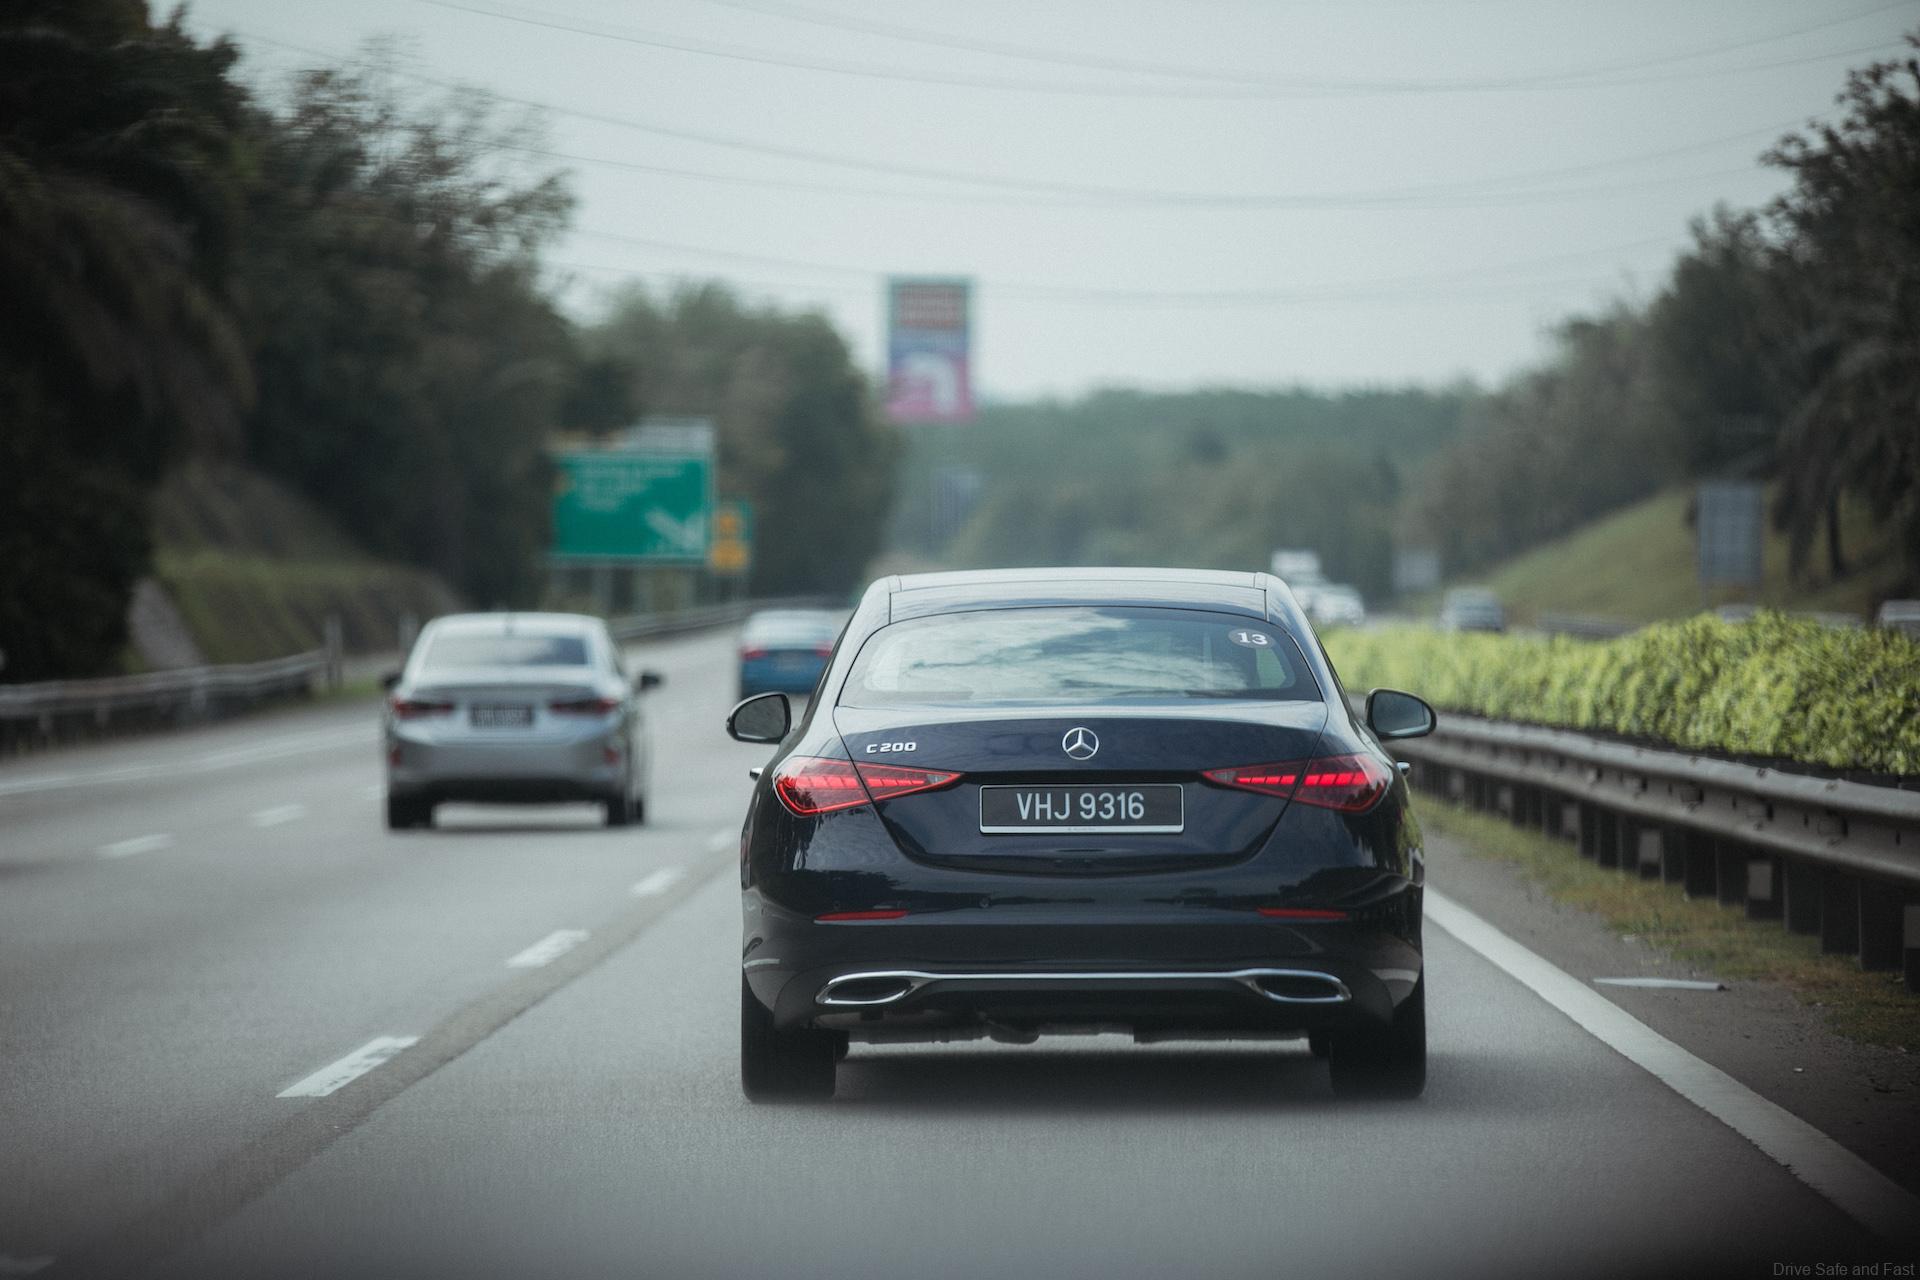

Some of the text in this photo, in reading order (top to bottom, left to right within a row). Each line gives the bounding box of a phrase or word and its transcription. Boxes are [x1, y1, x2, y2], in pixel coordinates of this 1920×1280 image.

[1237, 631, 1268, 645] 13
[866, 741, 917, 754] C 200
[1016, 792, 1145, 820] VHJ 9316
